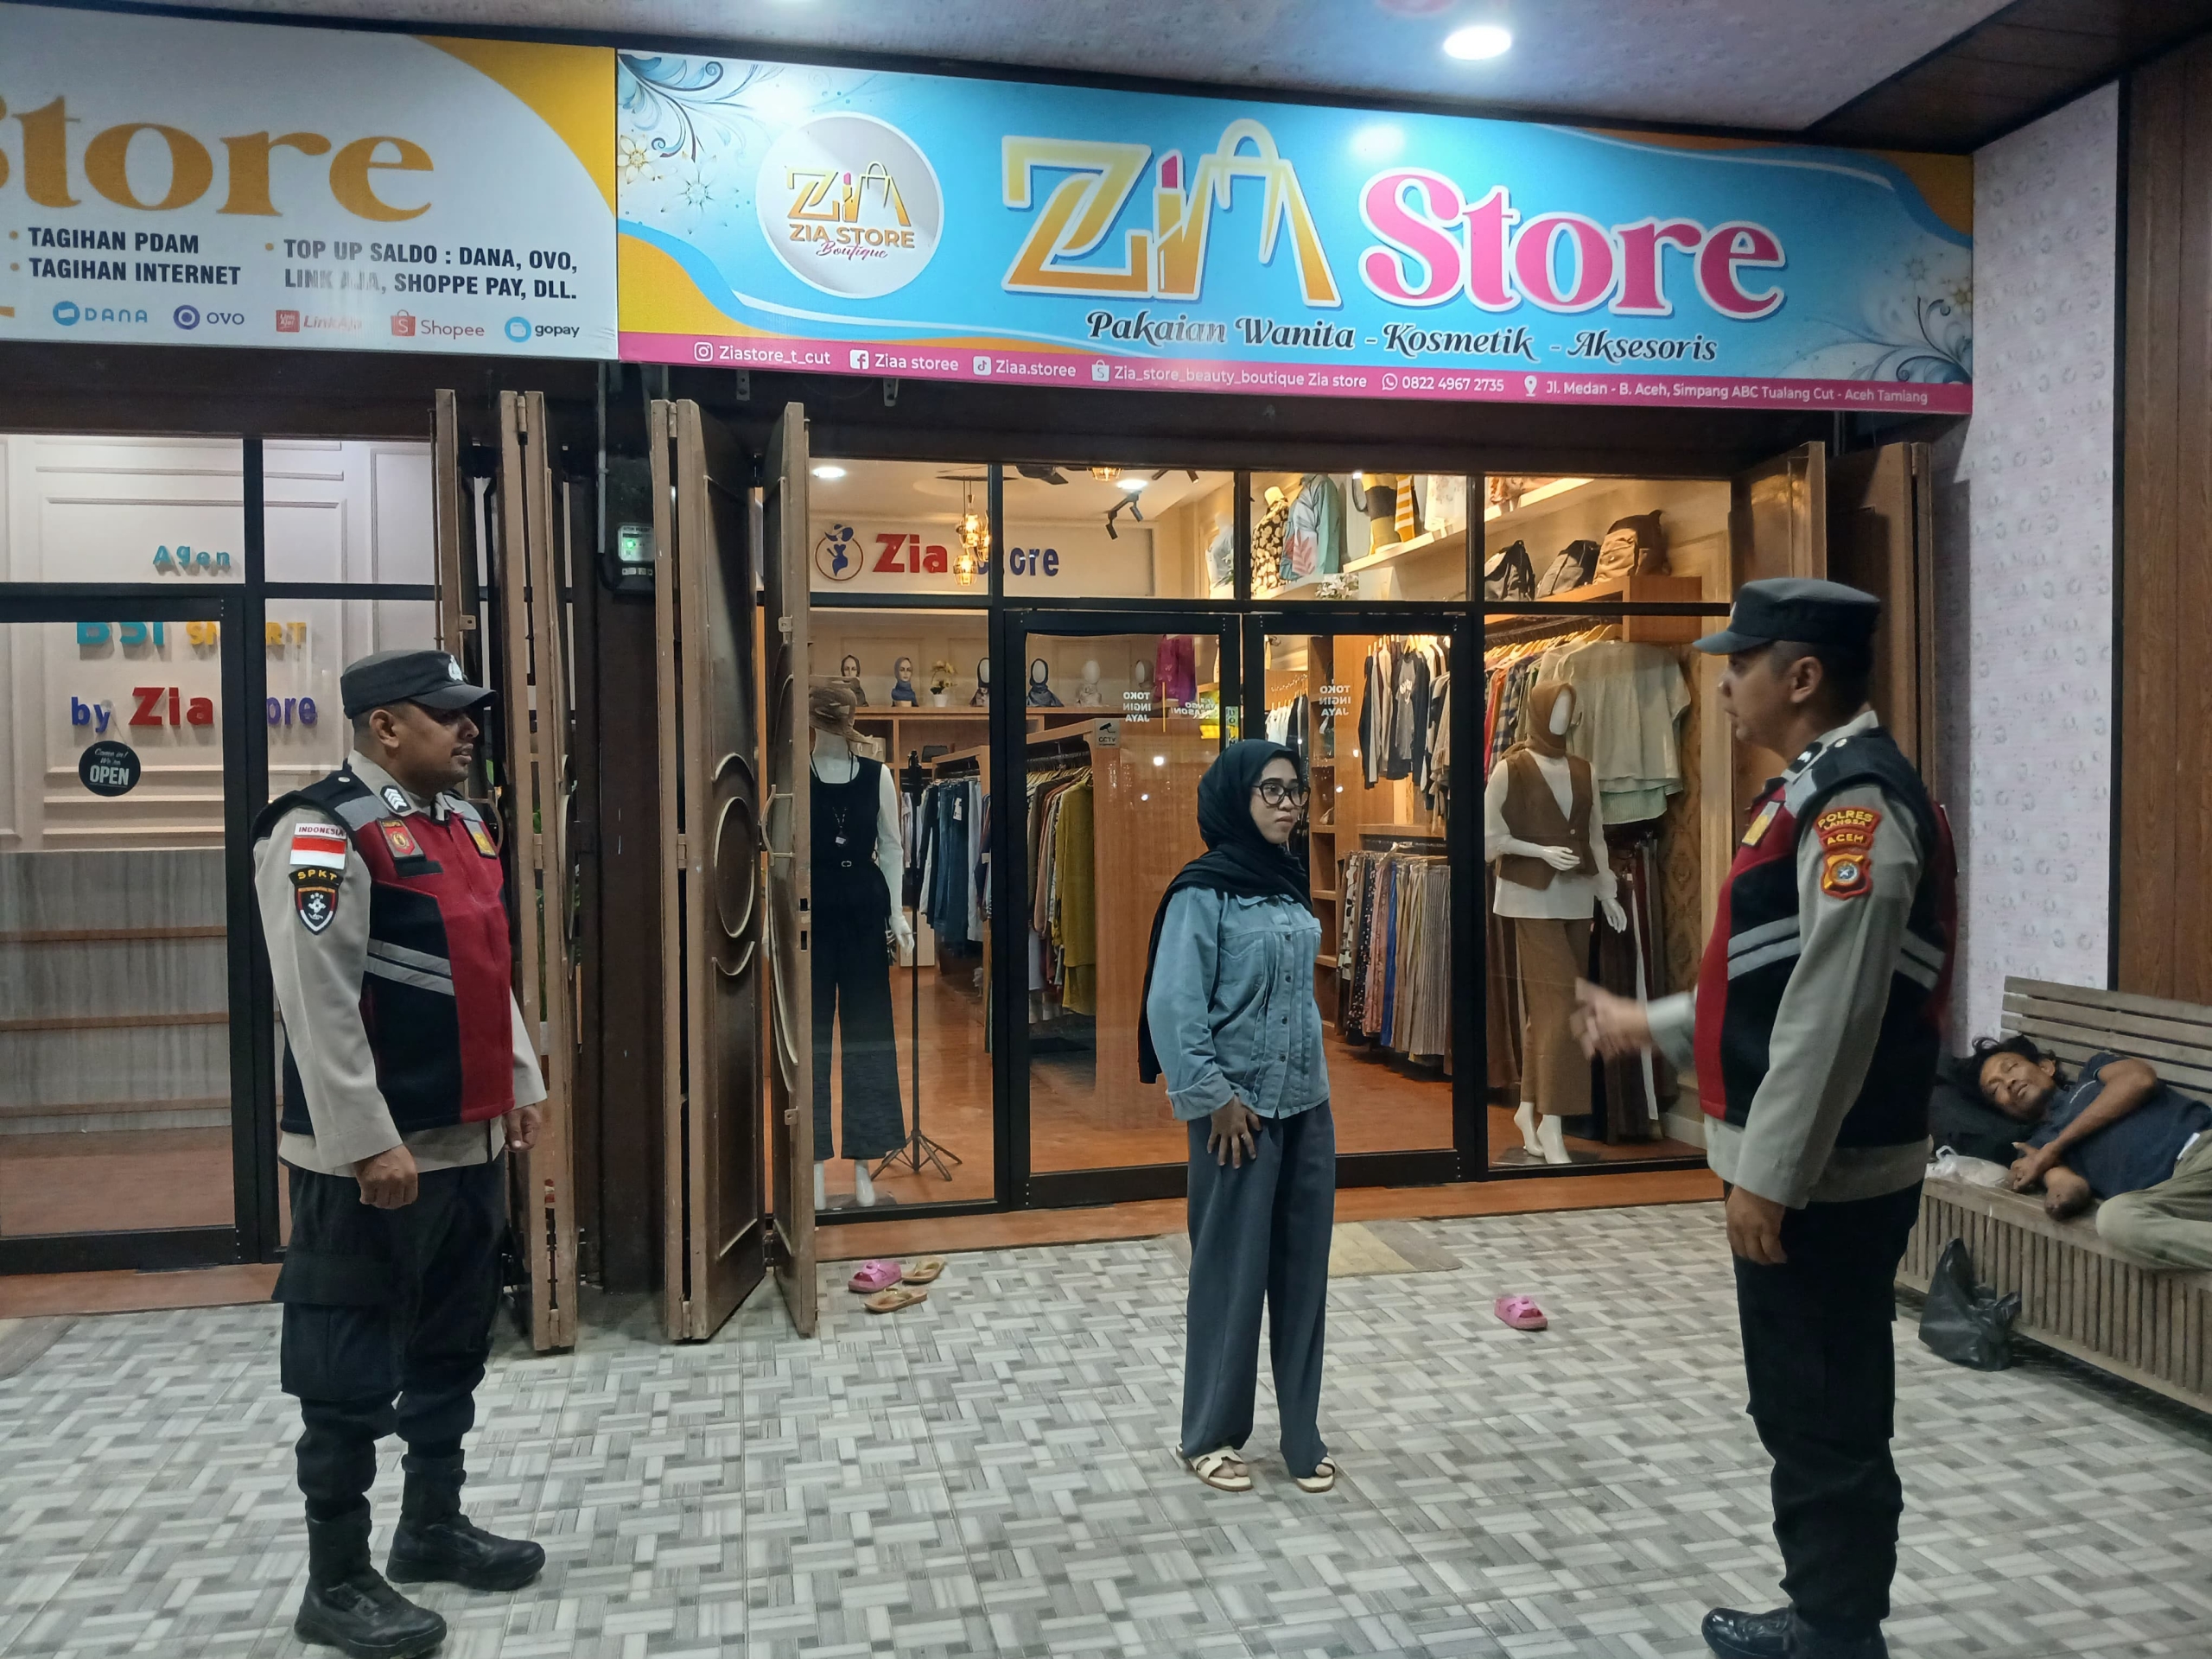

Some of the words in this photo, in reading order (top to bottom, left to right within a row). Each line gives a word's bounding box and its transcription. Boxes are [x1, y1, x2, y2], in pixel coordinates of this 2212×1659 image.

[0, 92, 434, 222] tore
[28, 227, 126, 251] TAGIHAN
[135, 232, 199, 254] PDAM
[789, 223, 830, 243] ZIA
[836, 226, 915, 248] STORE
[1360, 167, 1786, 319] Store
[283, 238, 326, 259] TOP
[334, 241, 363, 261] UP
[370, 243, 437, 264] SALDO
[460, 247, 522, 270] DANA,
[529, 250, 577, 274] OVO,
[816, 240, 888, 261] Boutique
[29, 257, 126, 281] TAGIHAN
[135, 263, 241, 285] INTERNET
[285, 269, 334, 289] LINK
[394, 273, 478, 295] SHOPPE
[486, 277, 526, 300] PAY,
[534, 279, 577, 299] DLL.
[85, 308, 148, 323] DANA
[207, 312, 245, 325] OVO
[421, 320, 485, 340] Shopee
[535, 325, 581, 338] gopay
[1087, 310, 1226, 346] Pakaian
[1235, 318, 1355, 348] Wanita
[719, 345, 830, 365] Ziastore_t_cut
[874, 353, 906, 369] Ziaa
[911, 355, 959, 372] storee
[995, 359, 1077, 378] Ziaa.storee
[1114, 365, 1304, 389] Zia_store_beauty_boutique
[1308, 372, 1329, 386] Zia
[1332, 374, 1367, 388] store
[1402, 376, 1434, 390] 0822
[1438, 377, 1470, 391] 4967
[1473, 378, 1504, 391] 2735
[1564, 382, 1607, 395] Medan
[1619, 383, 1631, 396] B.
[1635, 383, 1670, 397] Aceh,
[1673, 384, 1728, 400] Simpang
[1732, 385, 1758, 397] ABC
[1762, 386, 1810, 403] Tualang
[1814, 388, 1834, 400] Cut
[1845, 389, 1874, 401] Aceh
[1877, 390, 1929, 405] Tamiang
[153, 545, 232, 567] Agen
[873, 533, 948, 573] Zia
[978, 546, 1059, 576] ore
[186, 621, 307, 646] SRT
[71, 696, 111, 734] by
[128, 687, 213, 726] Zia
[266, 696, 317, 726] ore
[90, 765, 130, 785] OPEN
[1817, 810, 1873, 829] POLRES
[298, 826, 346, 837] INDONESIA
[1827, 833, 1864, 845] ACEH
[298, 868, 337, 881] SPKT
